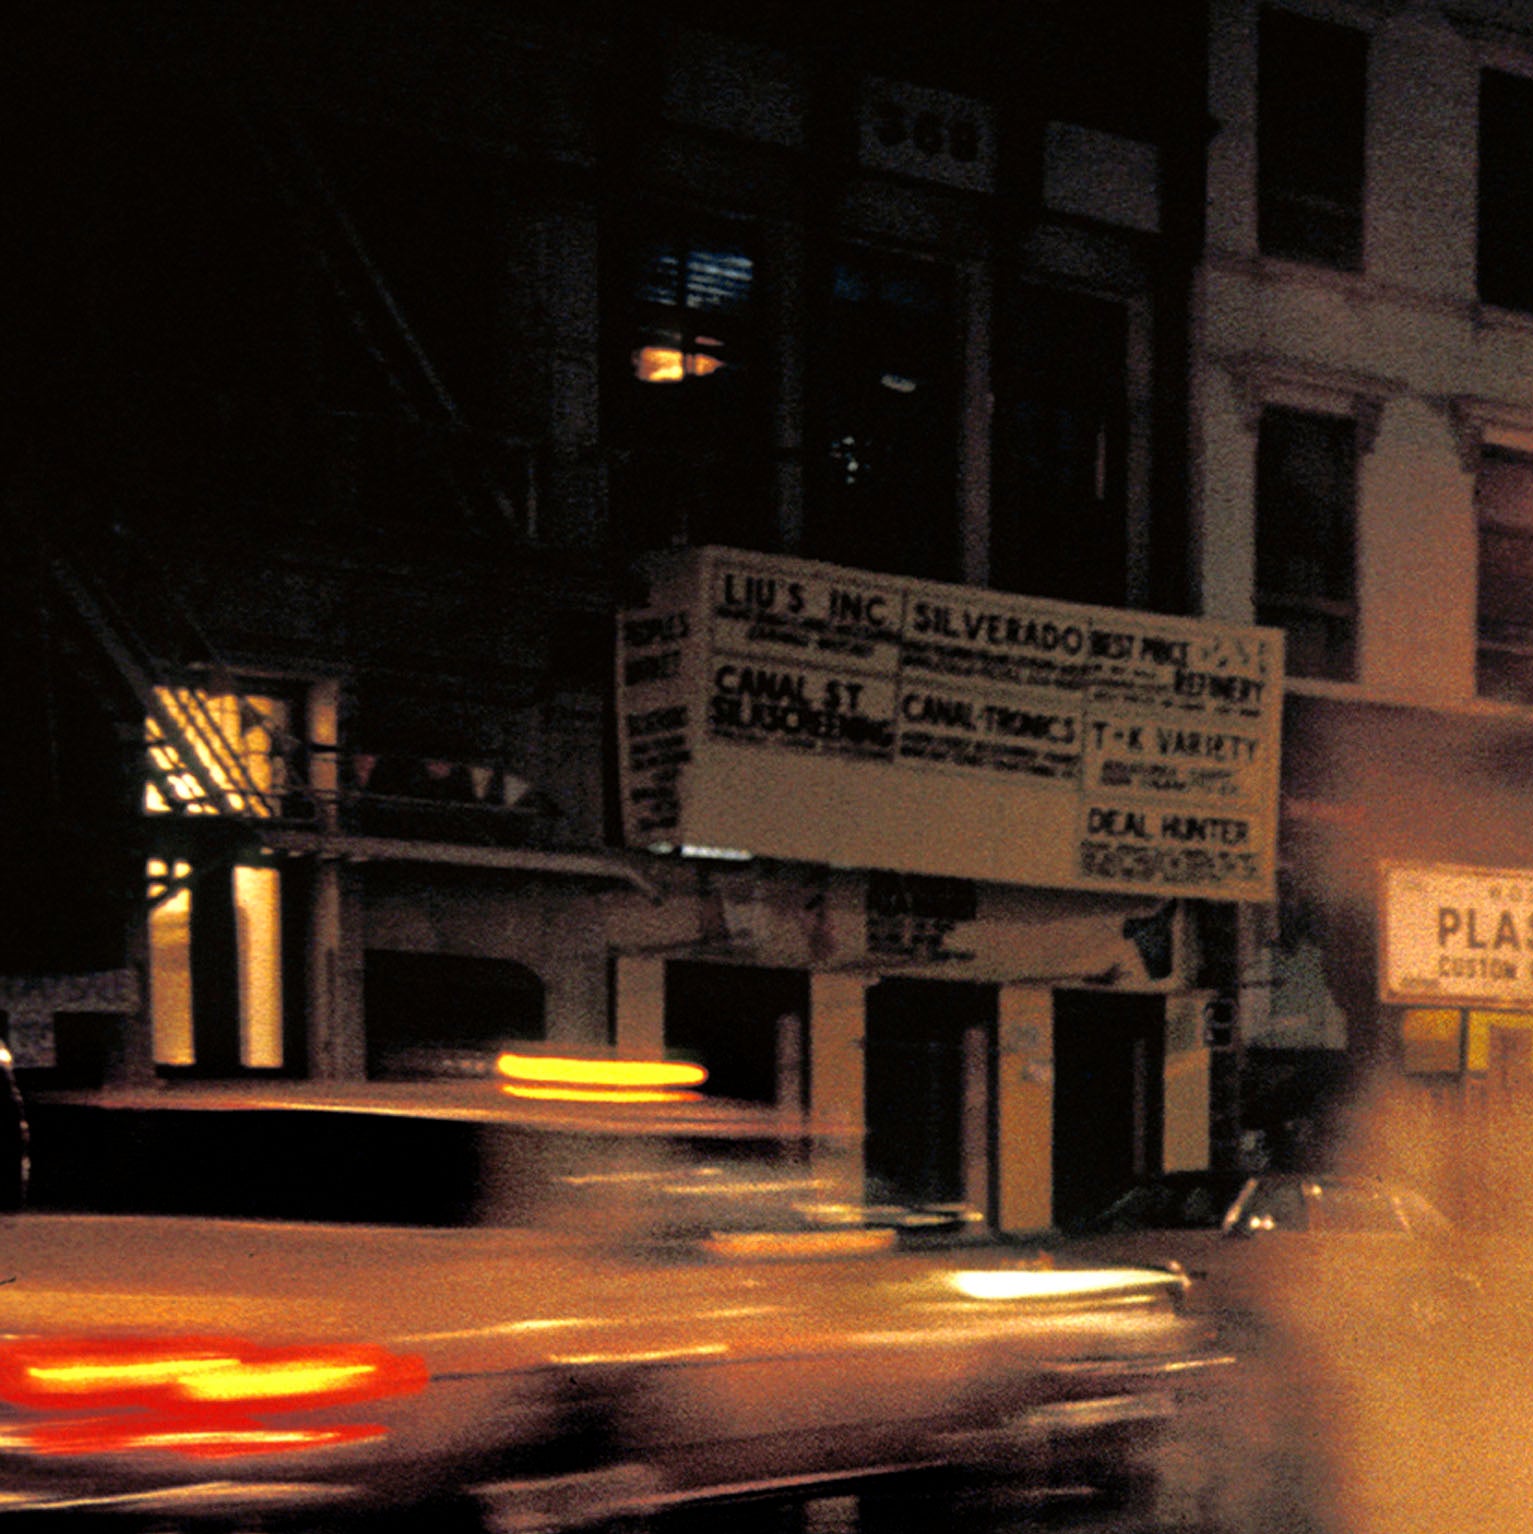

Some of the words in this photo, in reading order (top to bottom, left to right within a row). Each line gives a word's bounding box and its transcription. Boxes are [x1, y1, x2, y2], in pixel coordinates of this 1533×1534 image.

[912, 601, 1084, 657] SILVERADO
[714, 663, 808, 707] CANAL
[824, 680, 864, 712] ST
[1157, 726, 1259, 763] VARIETY
[1087, 806, 1155, 841] DEAL
[1161, 813, 1250, 846] HUNTER
[1437, 953, 1517, 980] CUSTOM
